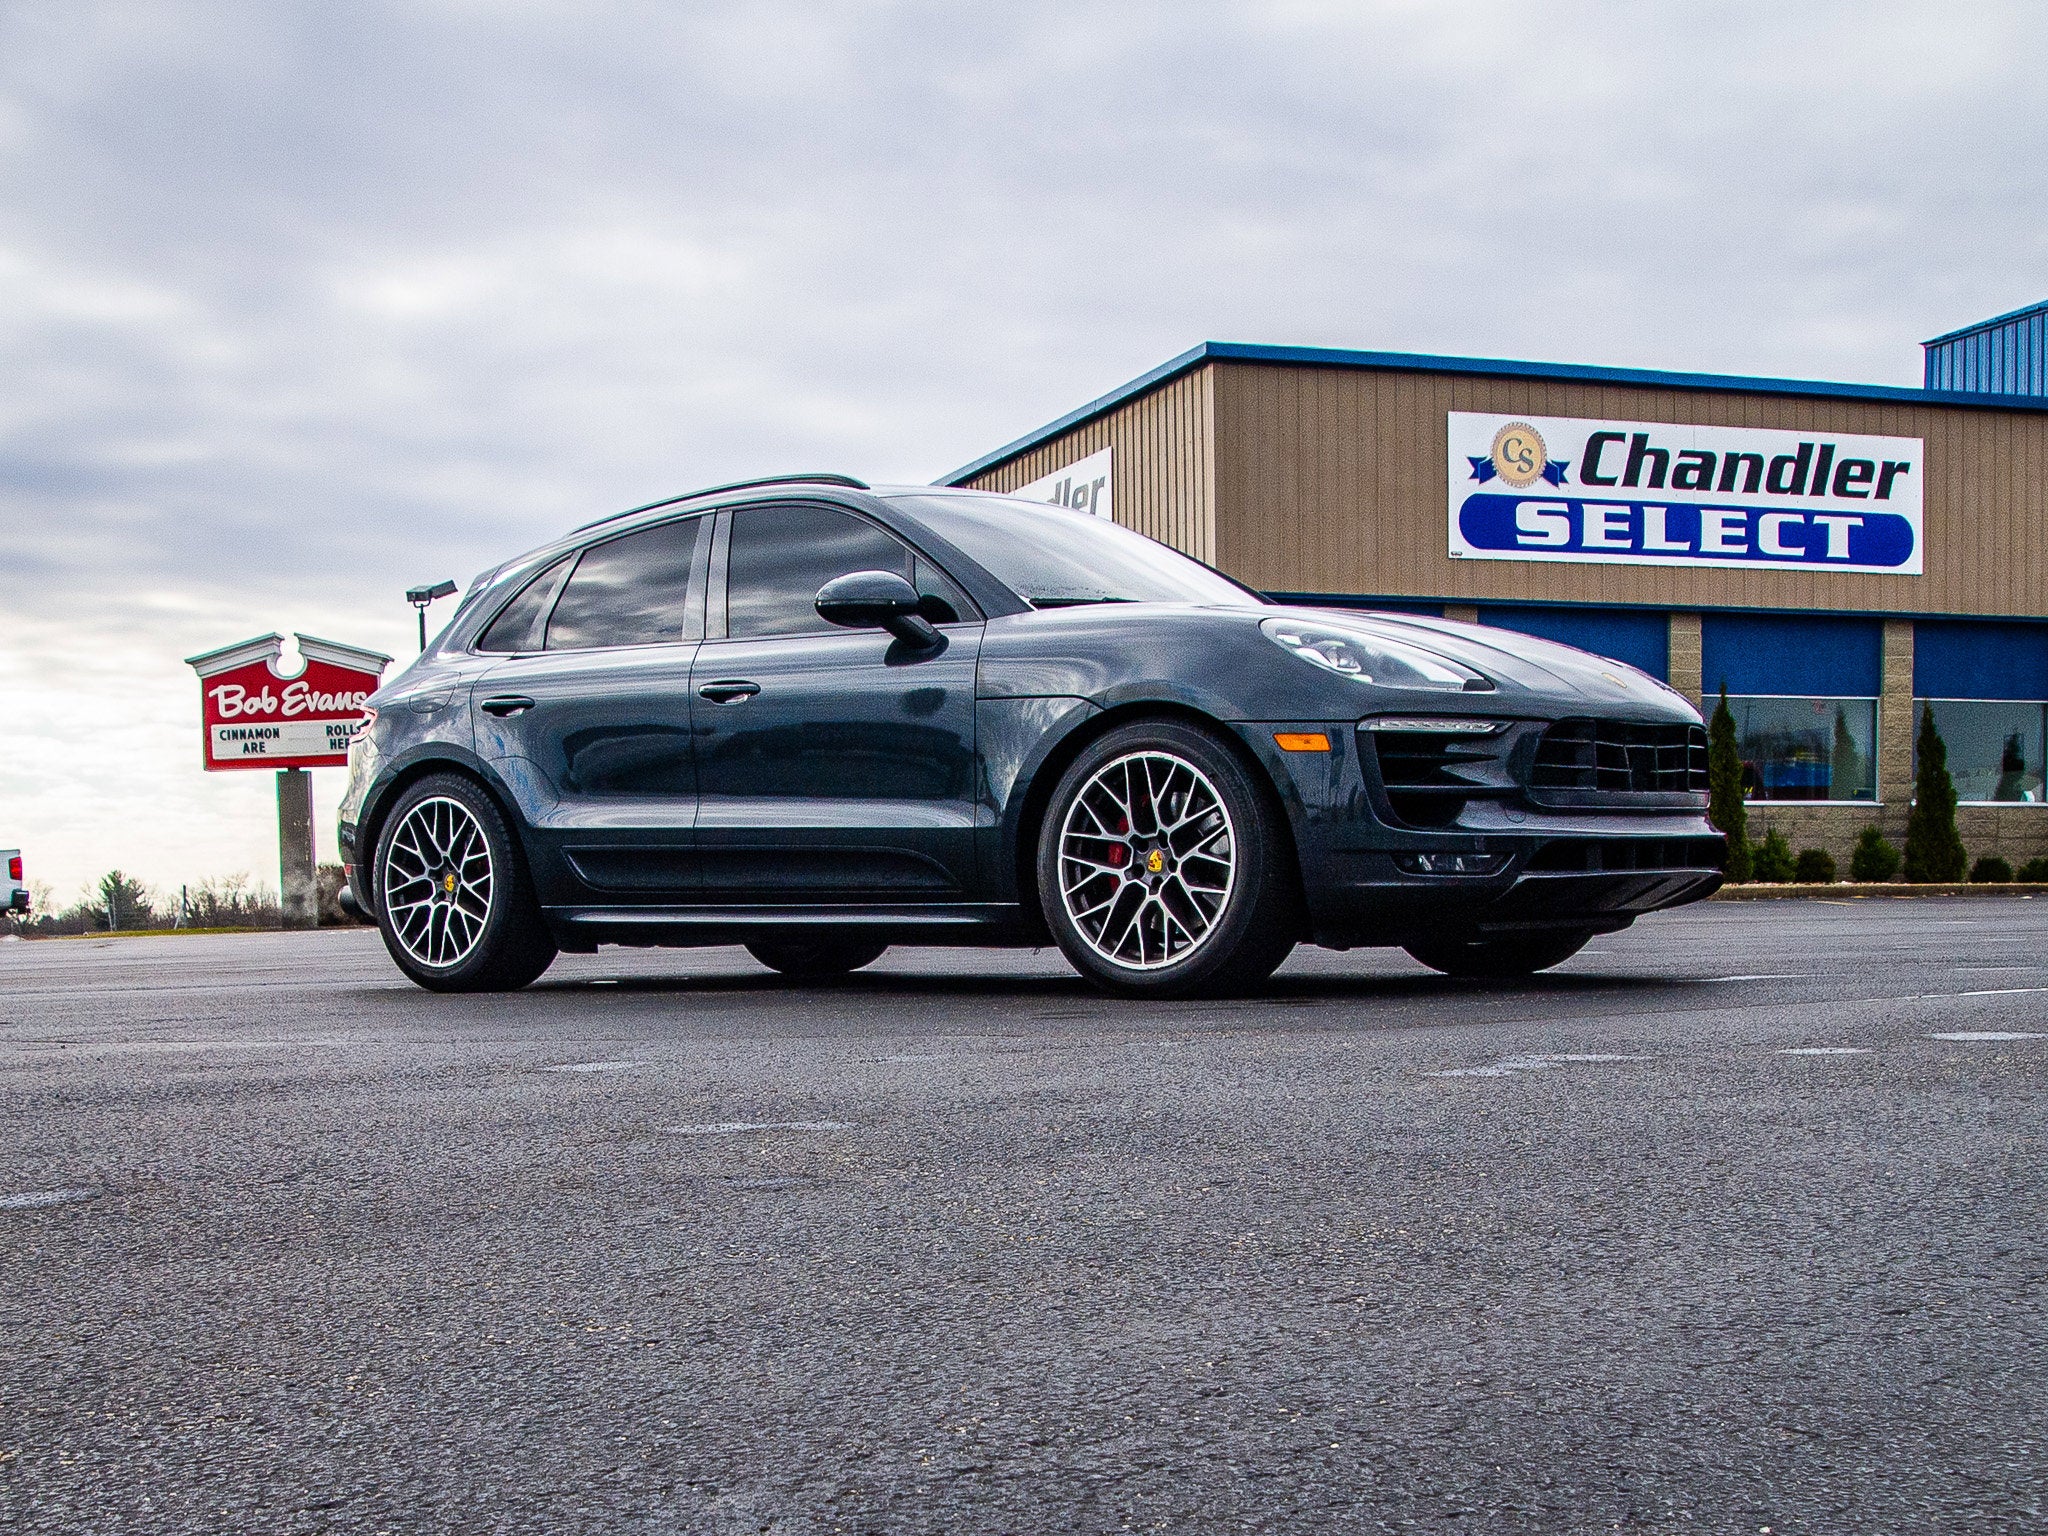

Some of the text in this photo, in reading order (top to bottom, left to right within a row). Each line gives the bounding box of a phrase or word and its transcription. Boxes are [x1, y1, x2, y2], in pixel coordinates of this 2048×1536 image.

[1502, 437, 1534, 473] CS
[1579, 430, 1911, 501] Chandler
[1515, 502, 1864, 559] SELECT
[208, 681, 367, 718] Bob Evans
[219, 727, 280, 741] CINNAMON
[242, 741, 266, 754] ARE
